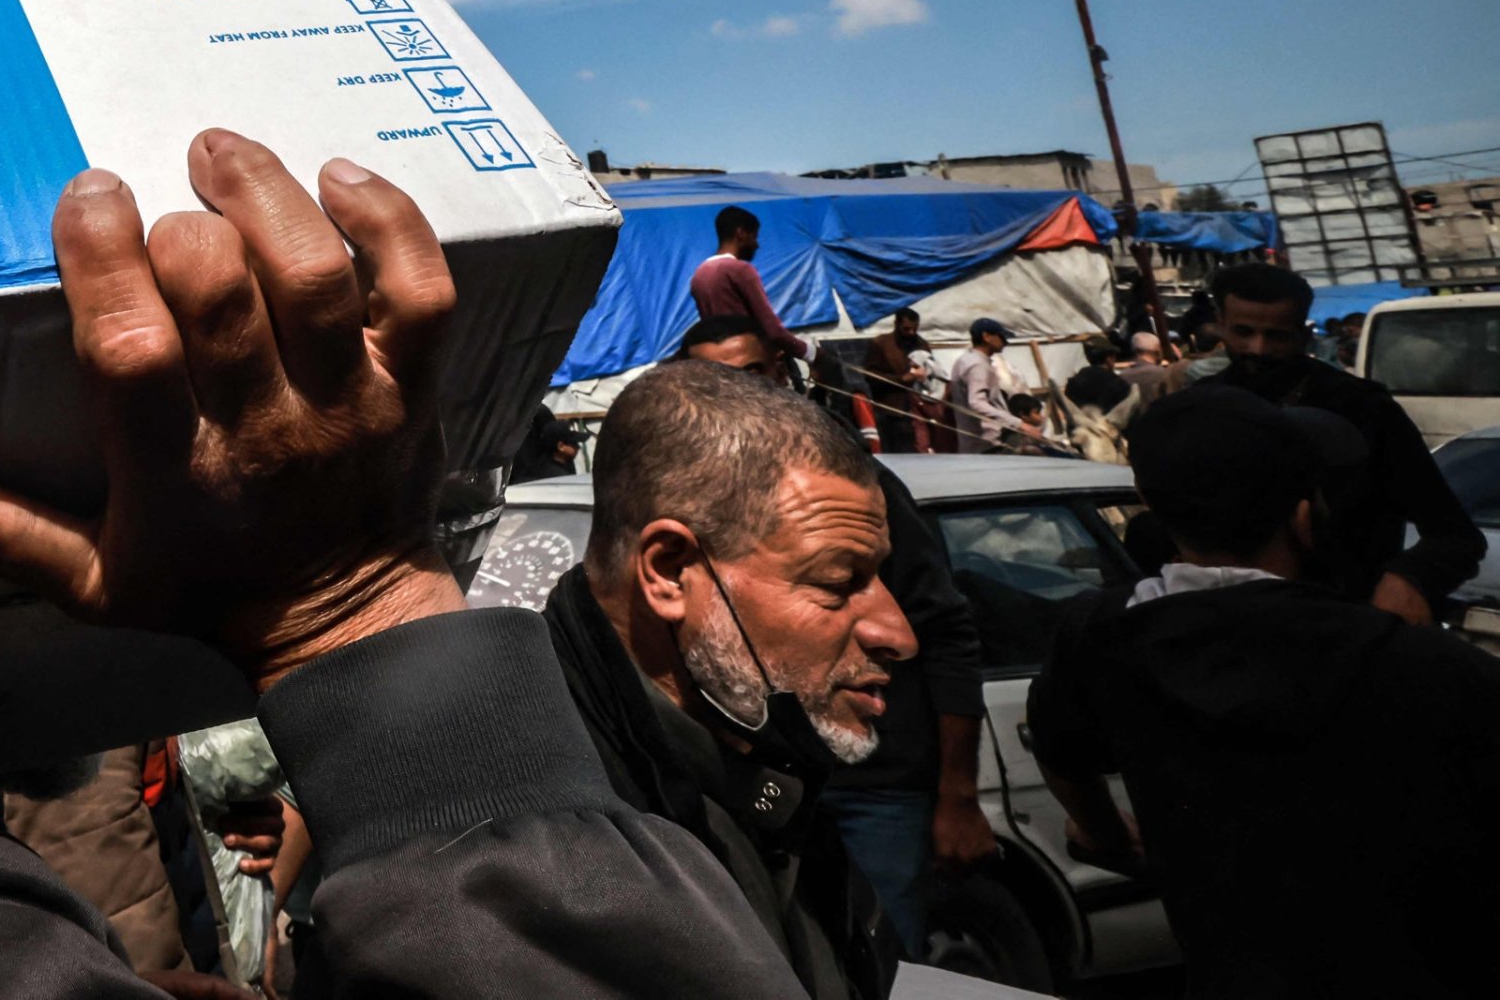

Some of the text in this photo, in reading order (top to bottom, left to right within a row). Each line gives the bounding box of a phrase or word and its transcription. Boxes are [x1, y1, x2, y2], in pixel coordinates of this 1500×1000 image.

[208, 24, 365, 43] KEEP AWAY FROM HEAT
[336, 72, 402, 86] KEEP DRY
[376, 125, 443, 142] UPWARD
